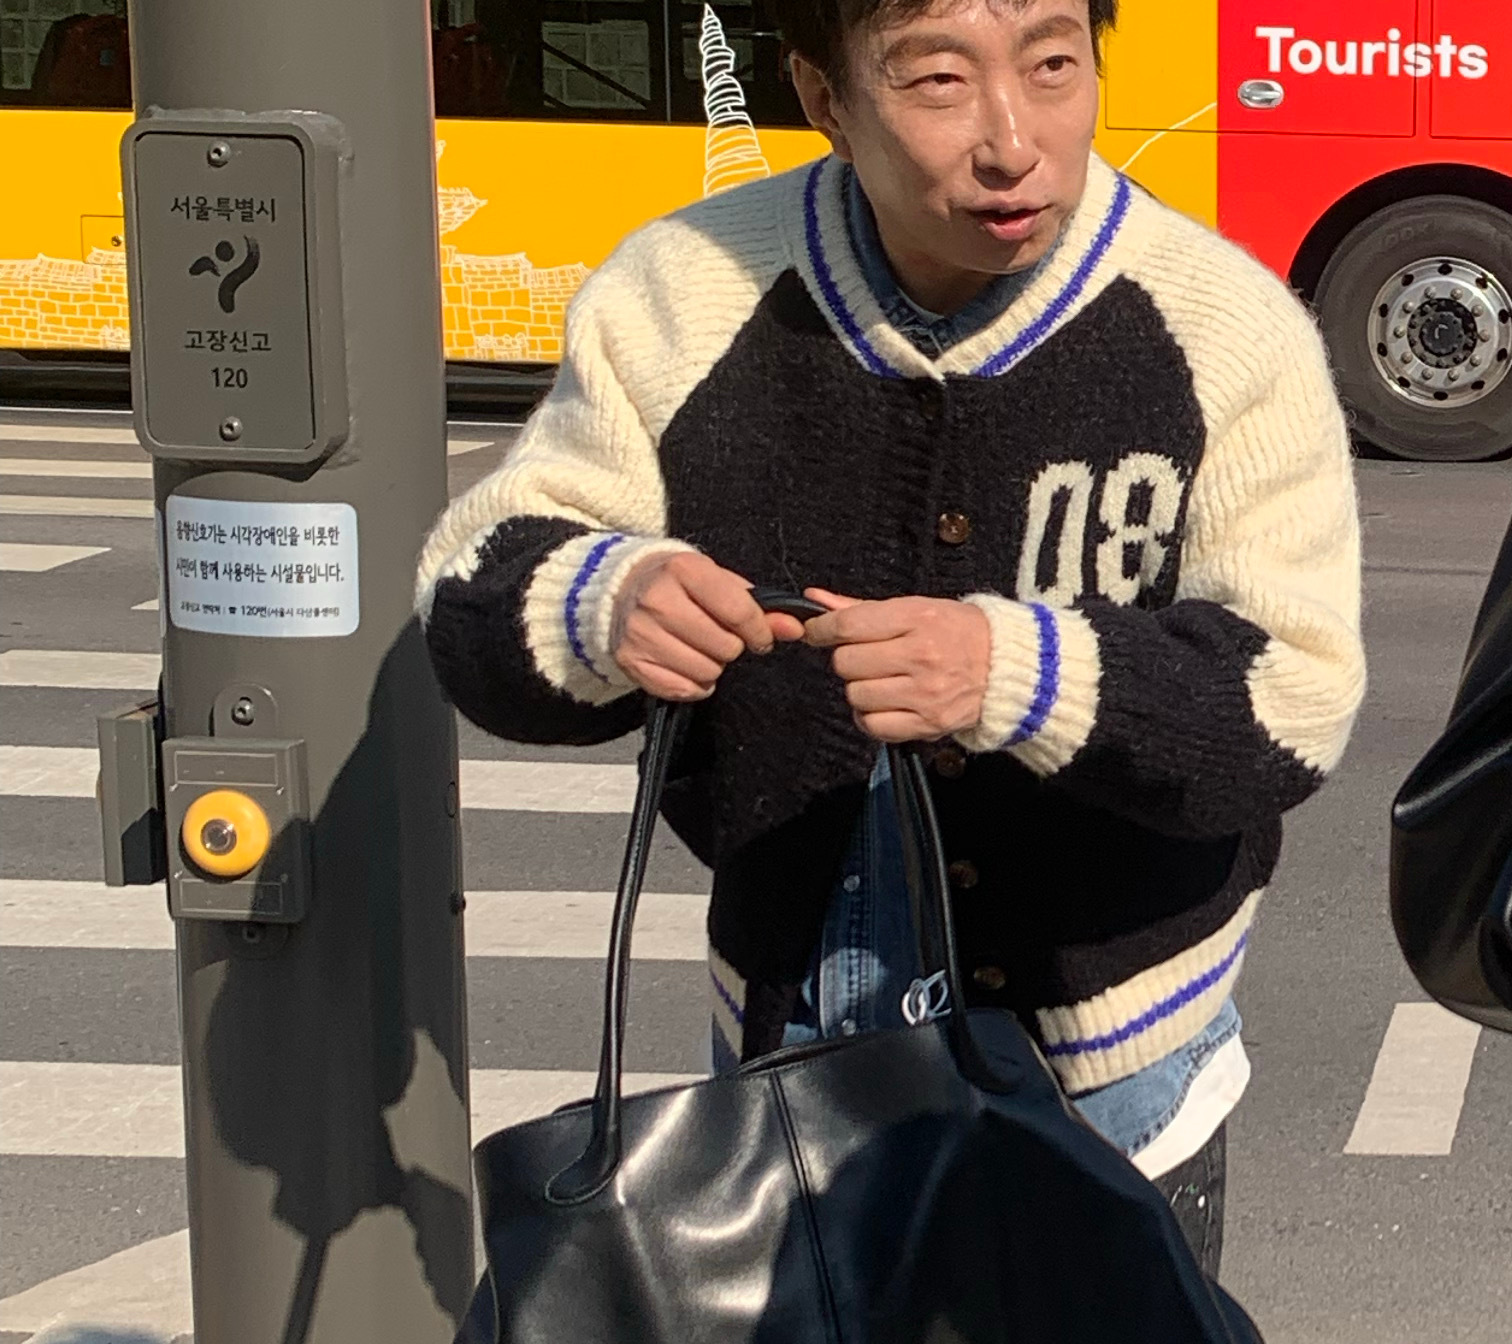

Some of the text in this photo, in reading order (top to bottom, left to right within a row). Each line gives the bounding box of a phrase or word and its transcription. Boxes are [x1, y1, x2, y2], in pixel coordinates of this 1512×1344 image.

[1255, 25, 1489, 79] Tourists
[170, 196, 276, 223] 서울특별시
[184, 330, 272, 353] 고장신고
[211, 367, 248, 389] 120
[230, 525, 300, 547] 시각장애인을
[303, 526, 340, 547] 비롯한
[200, 560, 219, 580] 함께
[222, 562, 267, 583] 사용하는
[270, 562, 345, 584] 시설물입니다.
